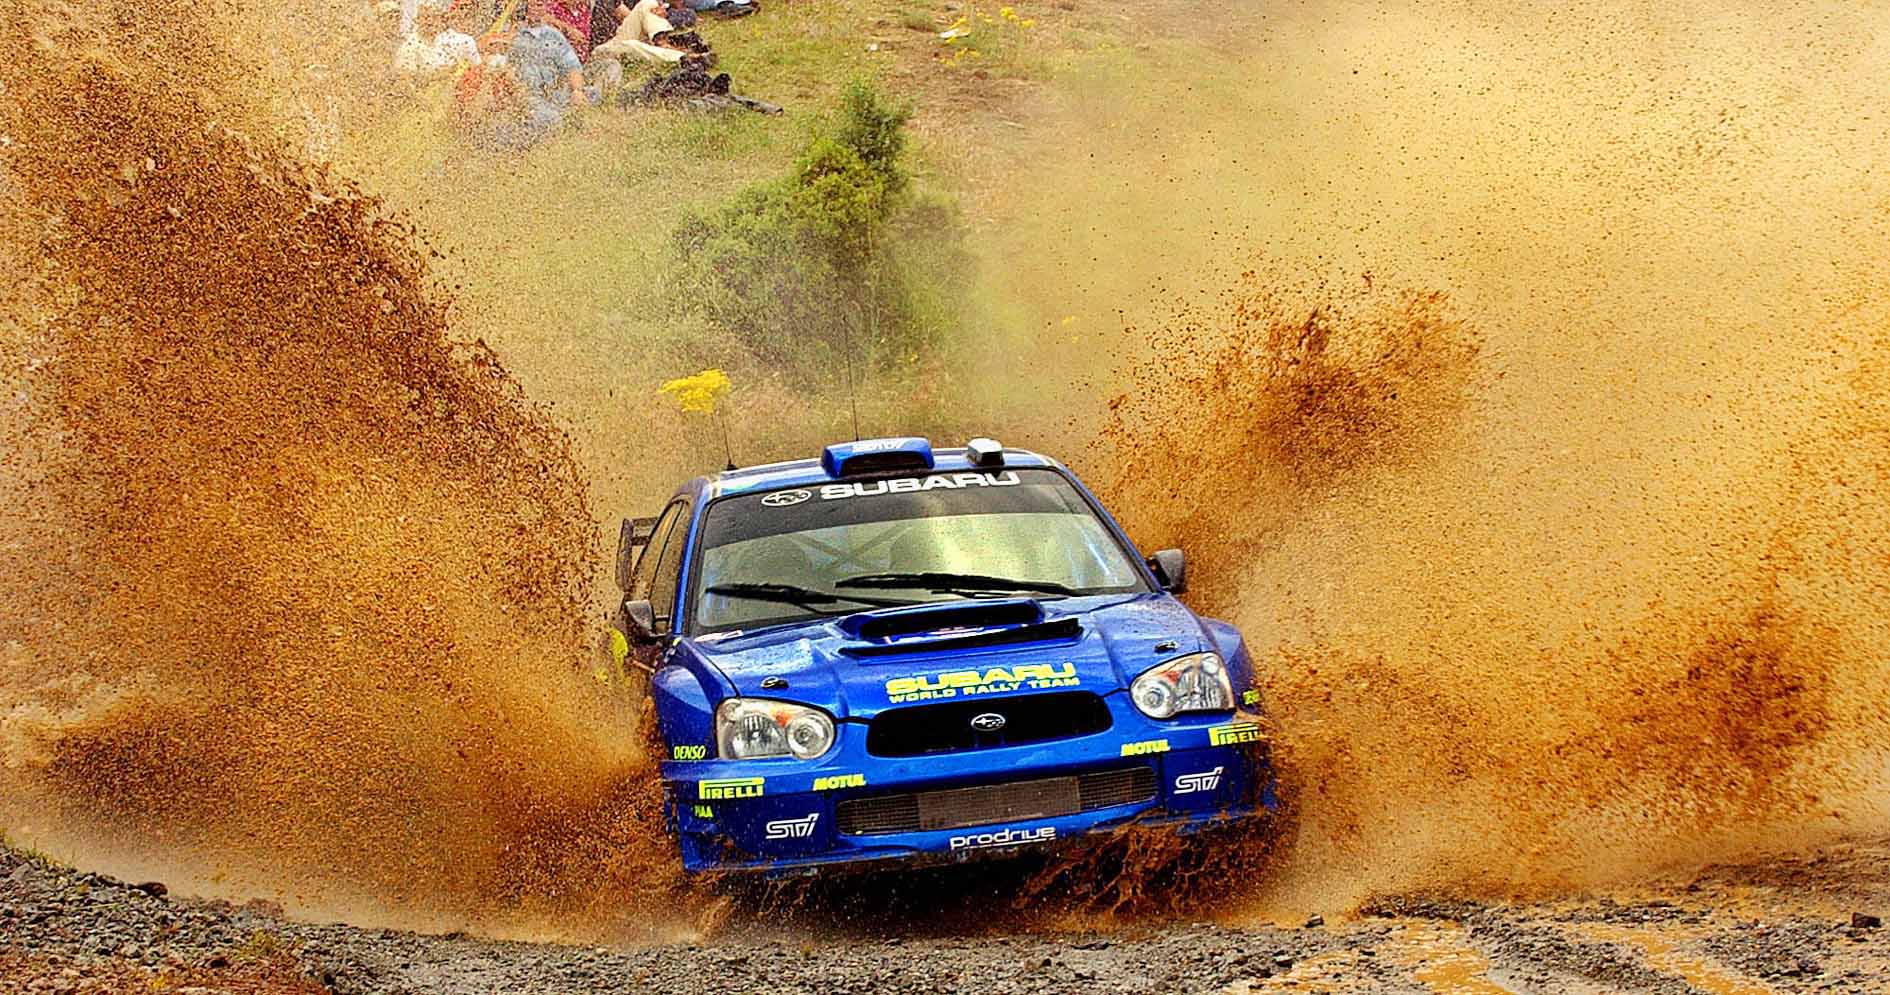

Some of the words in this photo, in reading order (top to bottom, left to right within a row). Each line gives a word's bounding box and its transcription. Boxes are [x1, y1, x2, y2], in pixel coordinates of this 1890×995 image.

[820, 471, 1021, 500] SUBARU
[885, 662, 1076, 694] SUBARU
[889, 688, 957, 703] WORLD
[963, 682, 1020, 696] RALLY
[1026, 677, 1081, 690] TEAM
[673, 745, 706, 760] DENSO
[1120, 739, 1171, 756] MOTUL
[699, 777, 765, 800] PIRELLI
[813, 774, 866, 791] MOTUL
[950, 827, 1056, 850] prodrive
